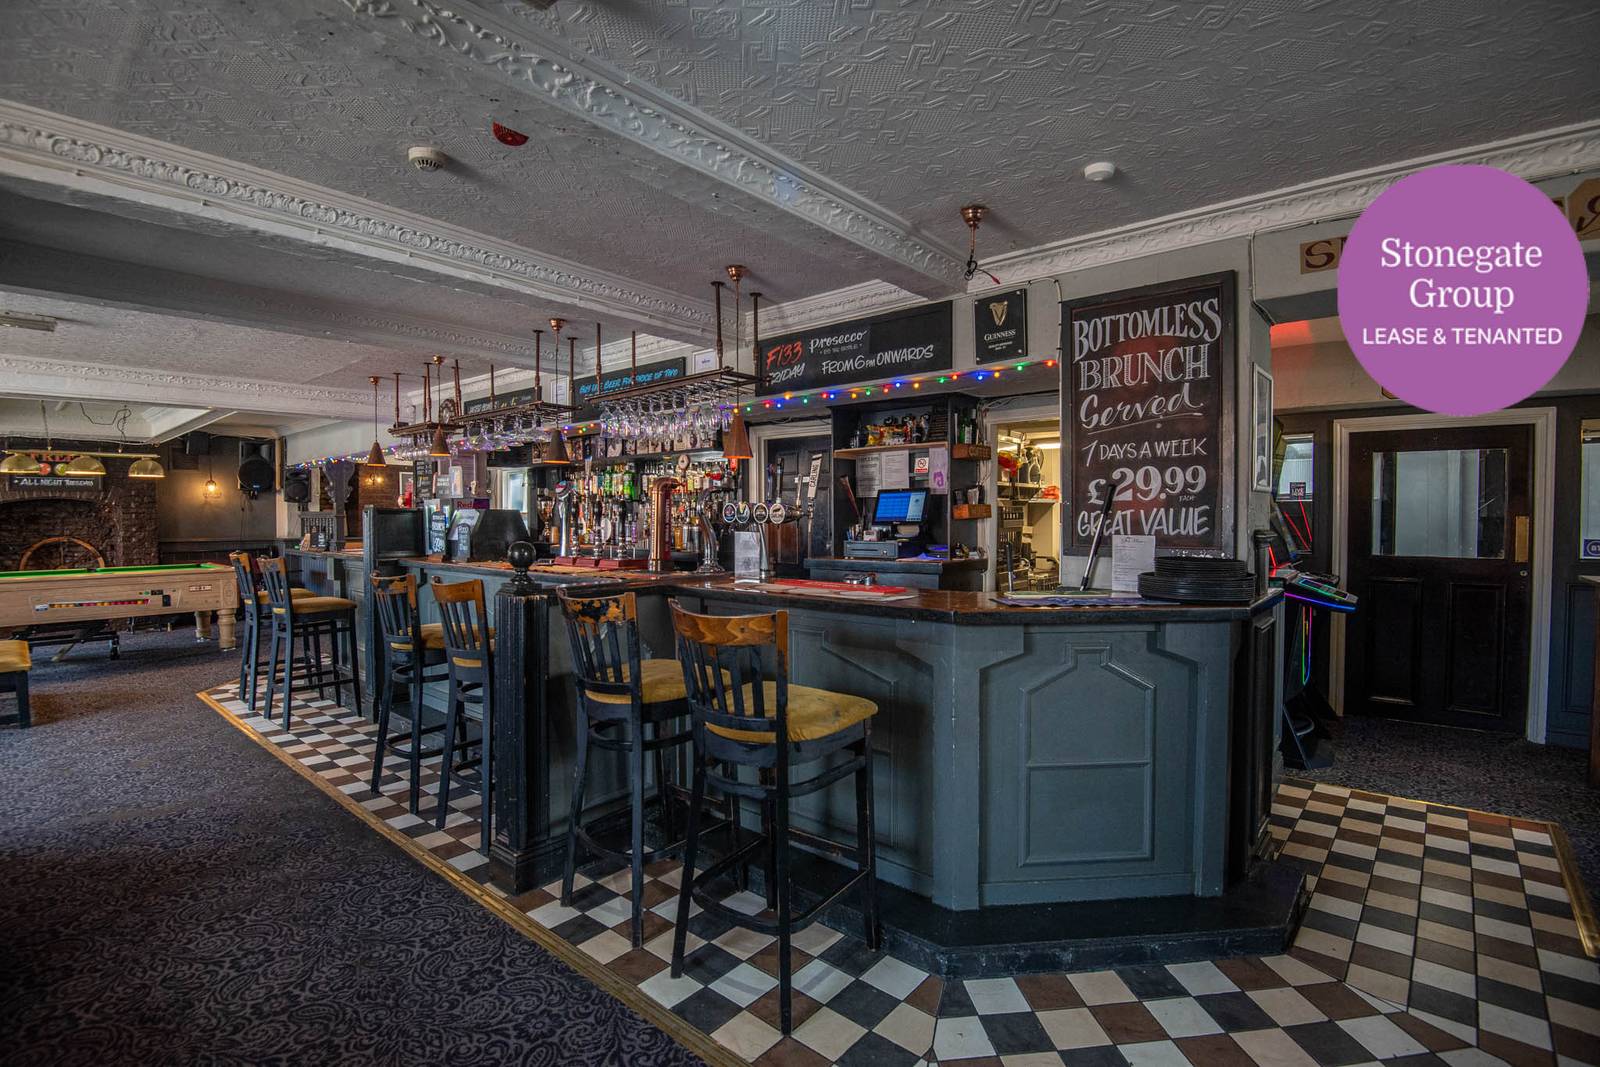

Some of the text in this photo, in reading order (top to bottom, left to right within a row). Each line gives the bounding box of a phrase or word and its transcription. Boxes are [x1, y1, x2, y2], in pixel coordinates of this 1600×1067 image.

[984, 328, 1017, 341] GUINNESS
[1072, 297, 1222, 364] BOTTOMLESS
[822, 355, 855, 375] FROM
[876, 344, 934, 366] ONWARDS
[1079, 343, 1211, 392] BRUNCH
[1080, 383, 1204, 429] Served
[1081, 437, 1208, 467] 7 DAYS A WEEK
[20, 478, 40, 486] ALL
[1087, 465, 1207, 505] £29.99
[1140, 505, 1210, 536] VALUE
